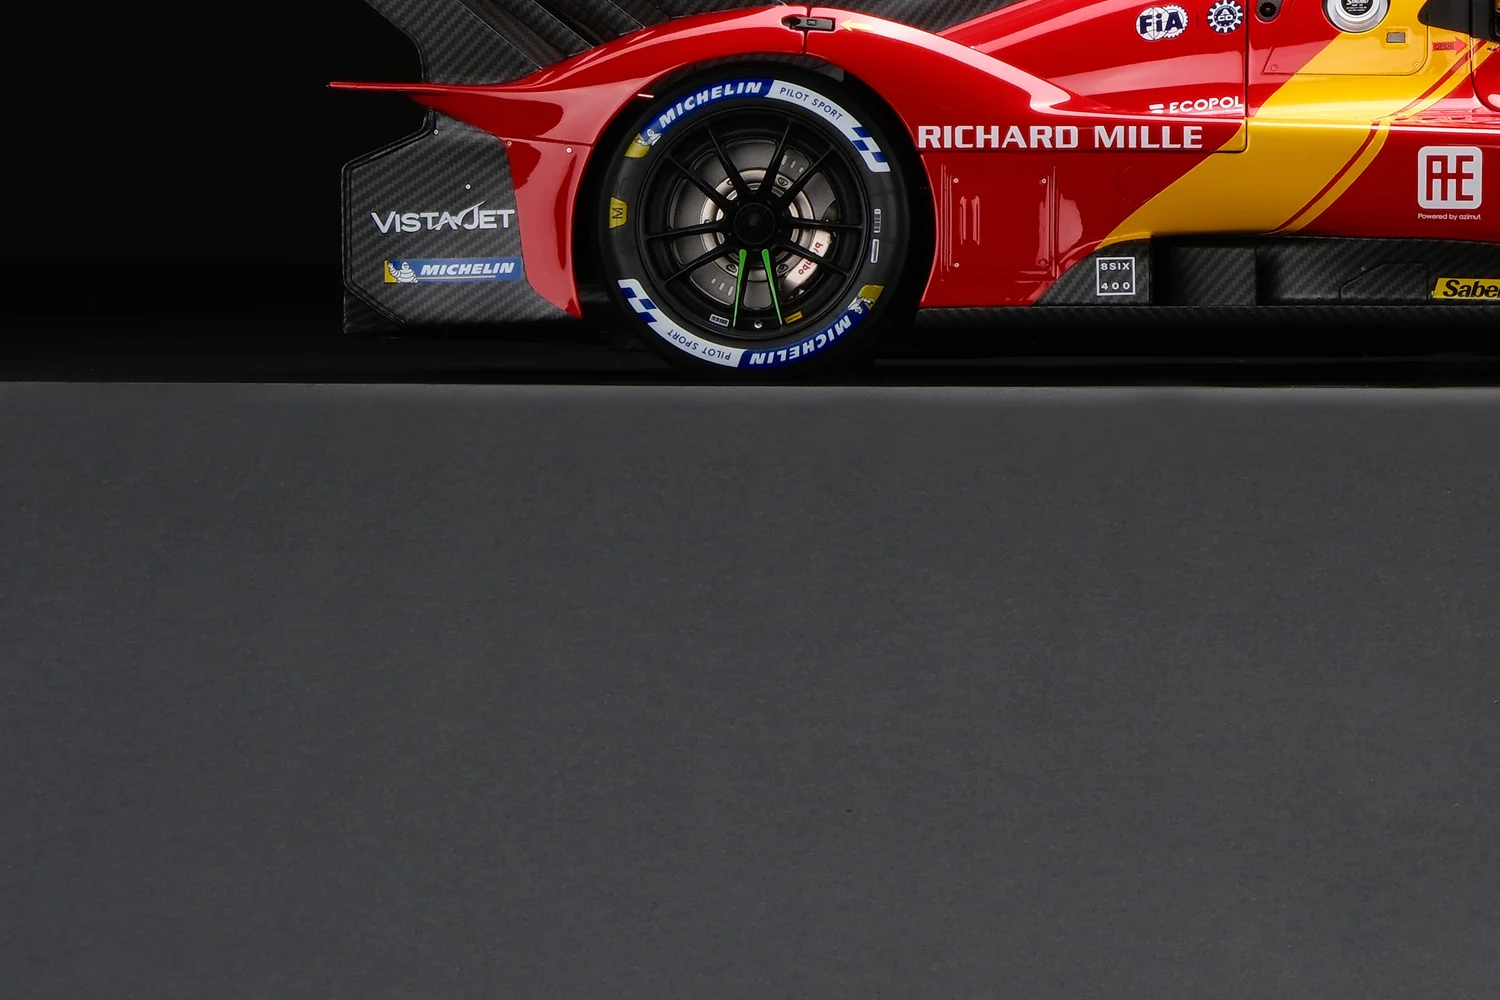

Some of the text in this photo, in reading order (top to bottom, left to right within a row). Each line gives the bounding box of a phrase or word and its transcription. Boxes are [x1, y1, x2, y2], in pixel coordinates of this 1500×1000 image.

[658, 81, 844, 129] MICHELIN PILOT SPORT
[1169, 95, 1244, 114] ECOPOL
[917, 125, 1204, 149] RICHARD MILLE
[1448, 213, 1458, 221] by
[420, 262, 515, 276] MICHELIN
[1100, 281, 1131, 290] 400
[666, 329, 731, 361] PILOT SPORT
[749, 315, 851, 365] MICHELIN
